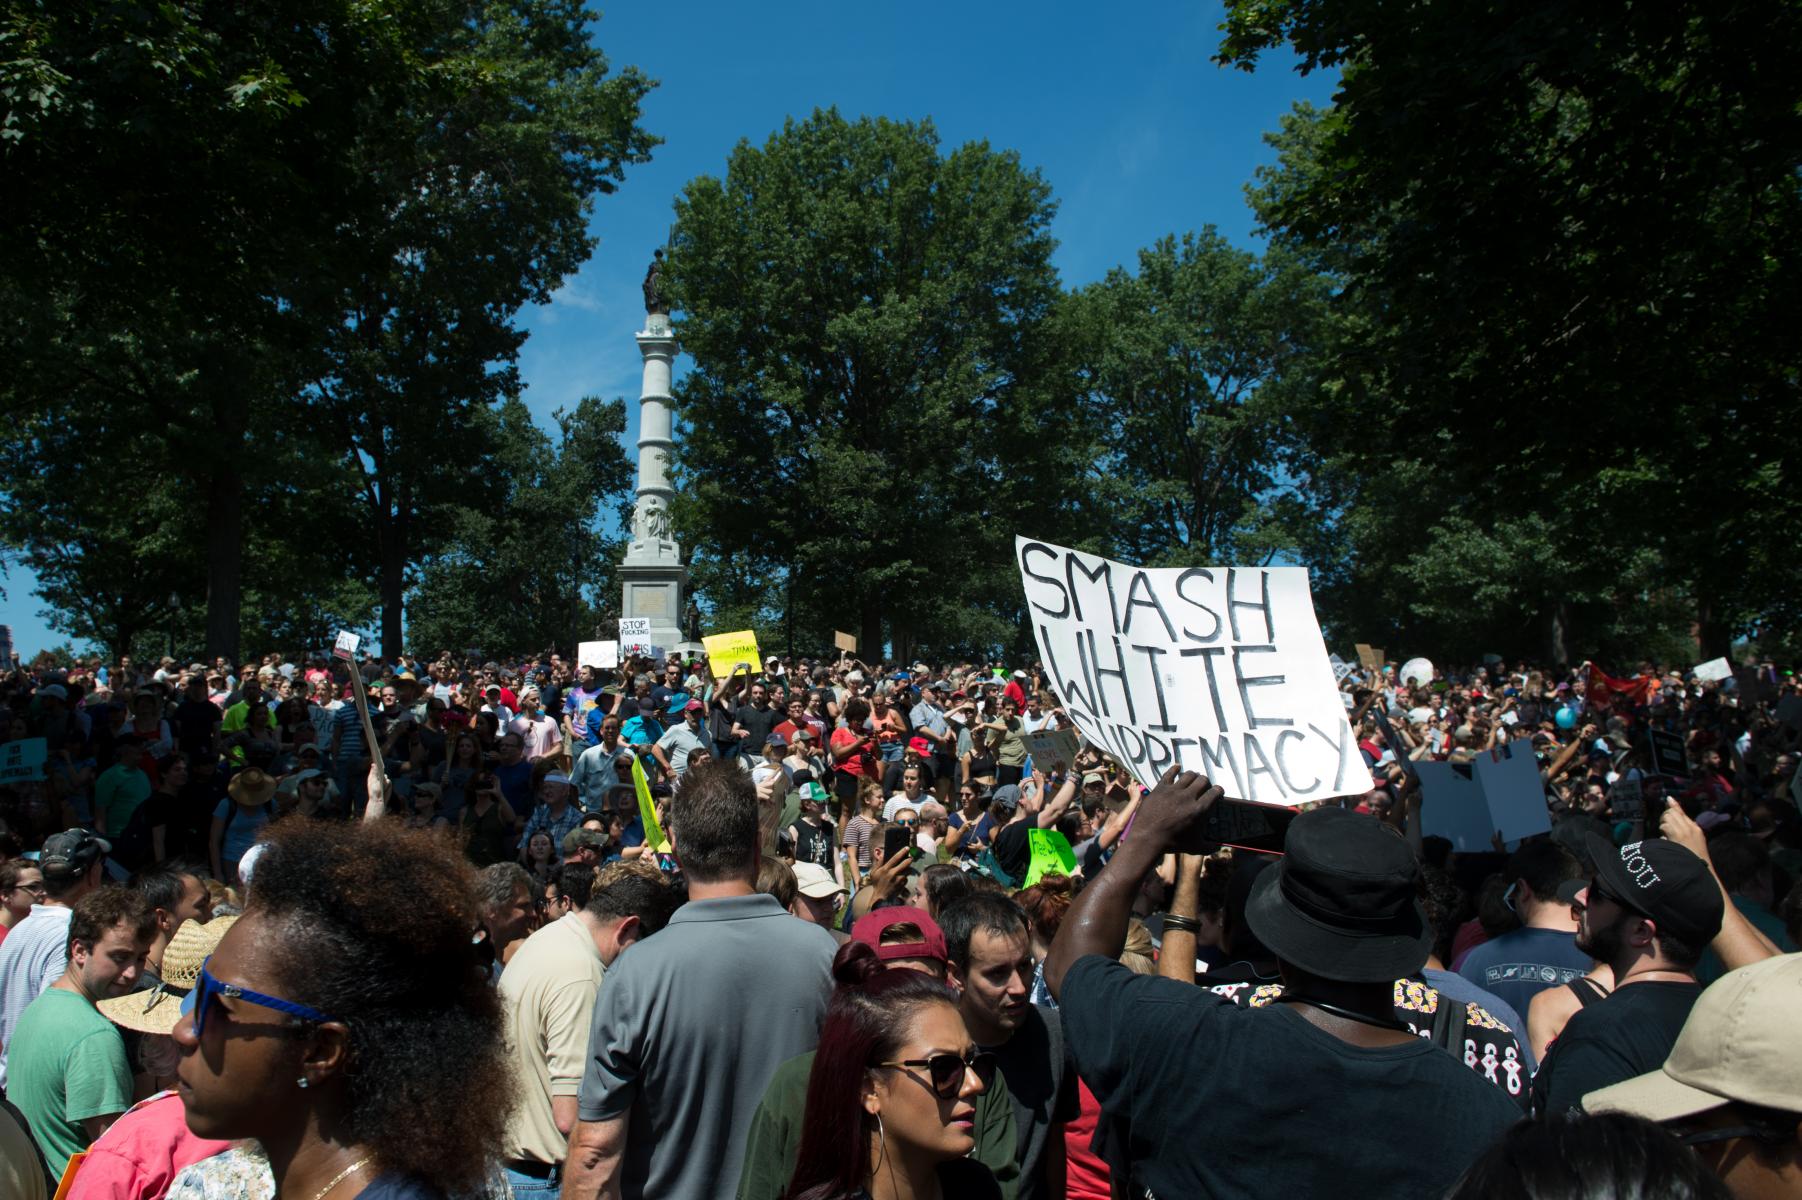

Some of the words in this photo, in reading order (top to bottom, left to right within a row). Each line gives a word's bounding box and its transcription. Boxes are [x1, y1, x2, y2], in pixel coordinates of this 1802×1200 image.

[622, 620, 646, 629] STOP
[1022, 542, 1275, 645] SMASH
[1040, 624, 1294, 732] WHITE
